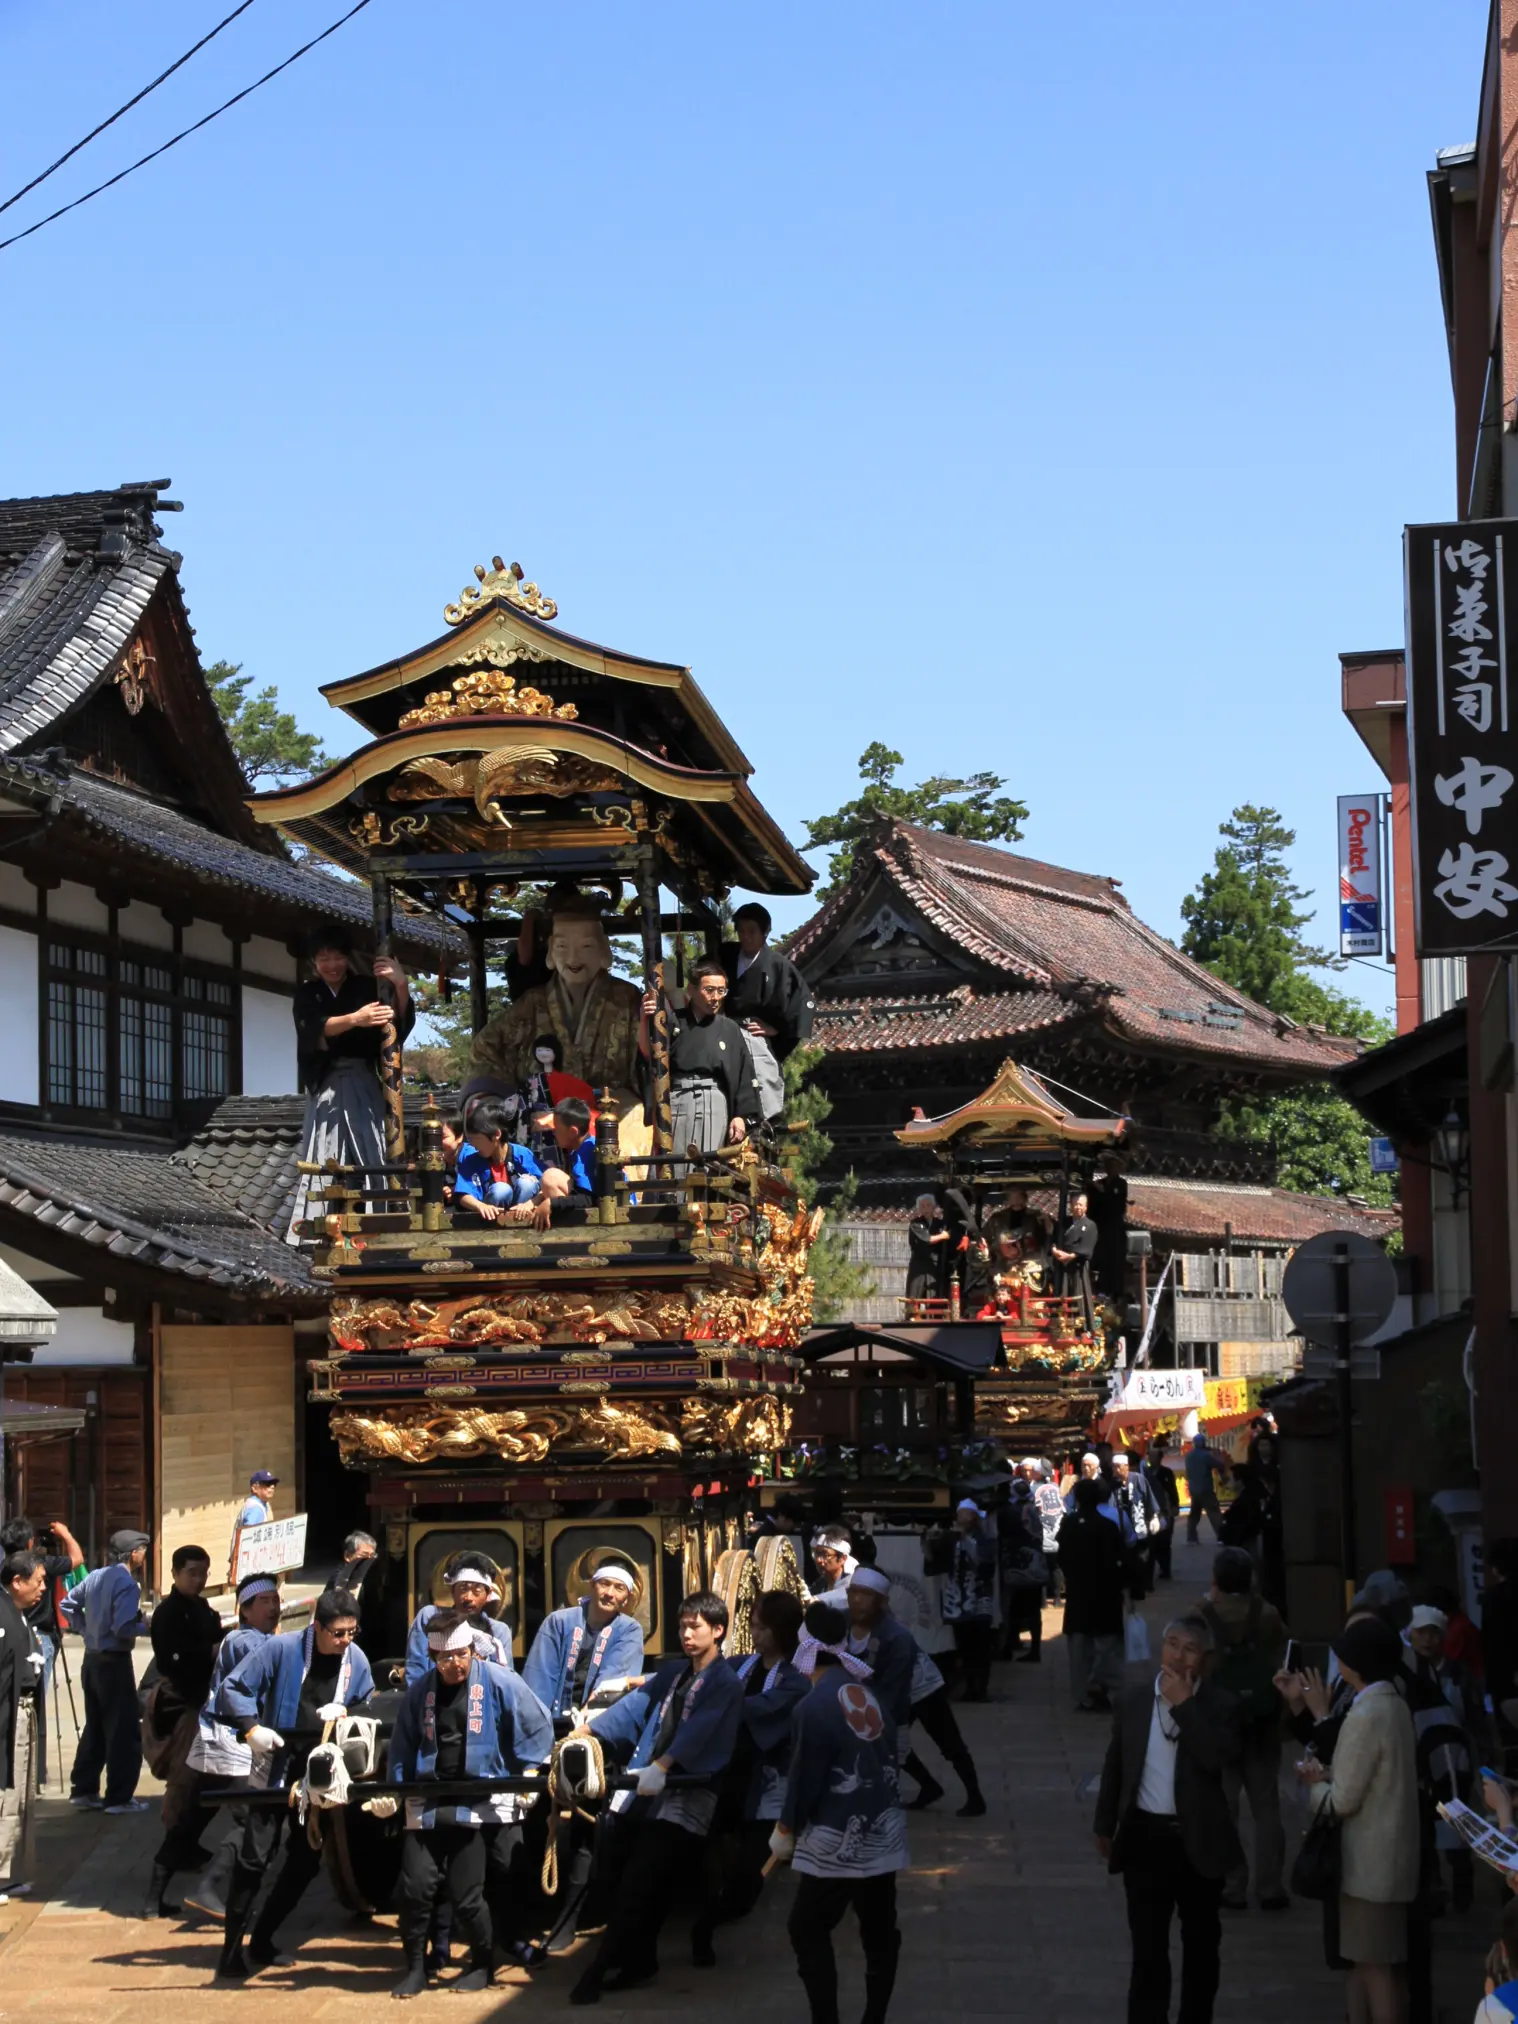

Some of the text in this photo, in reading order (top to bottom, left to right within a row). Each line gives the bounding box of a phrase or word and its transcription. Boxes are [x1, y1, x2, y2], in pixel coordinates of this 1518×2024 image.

[1348, 808, 1371, 875] Pentel
[469, 1683, 484, 1734] 東上町
